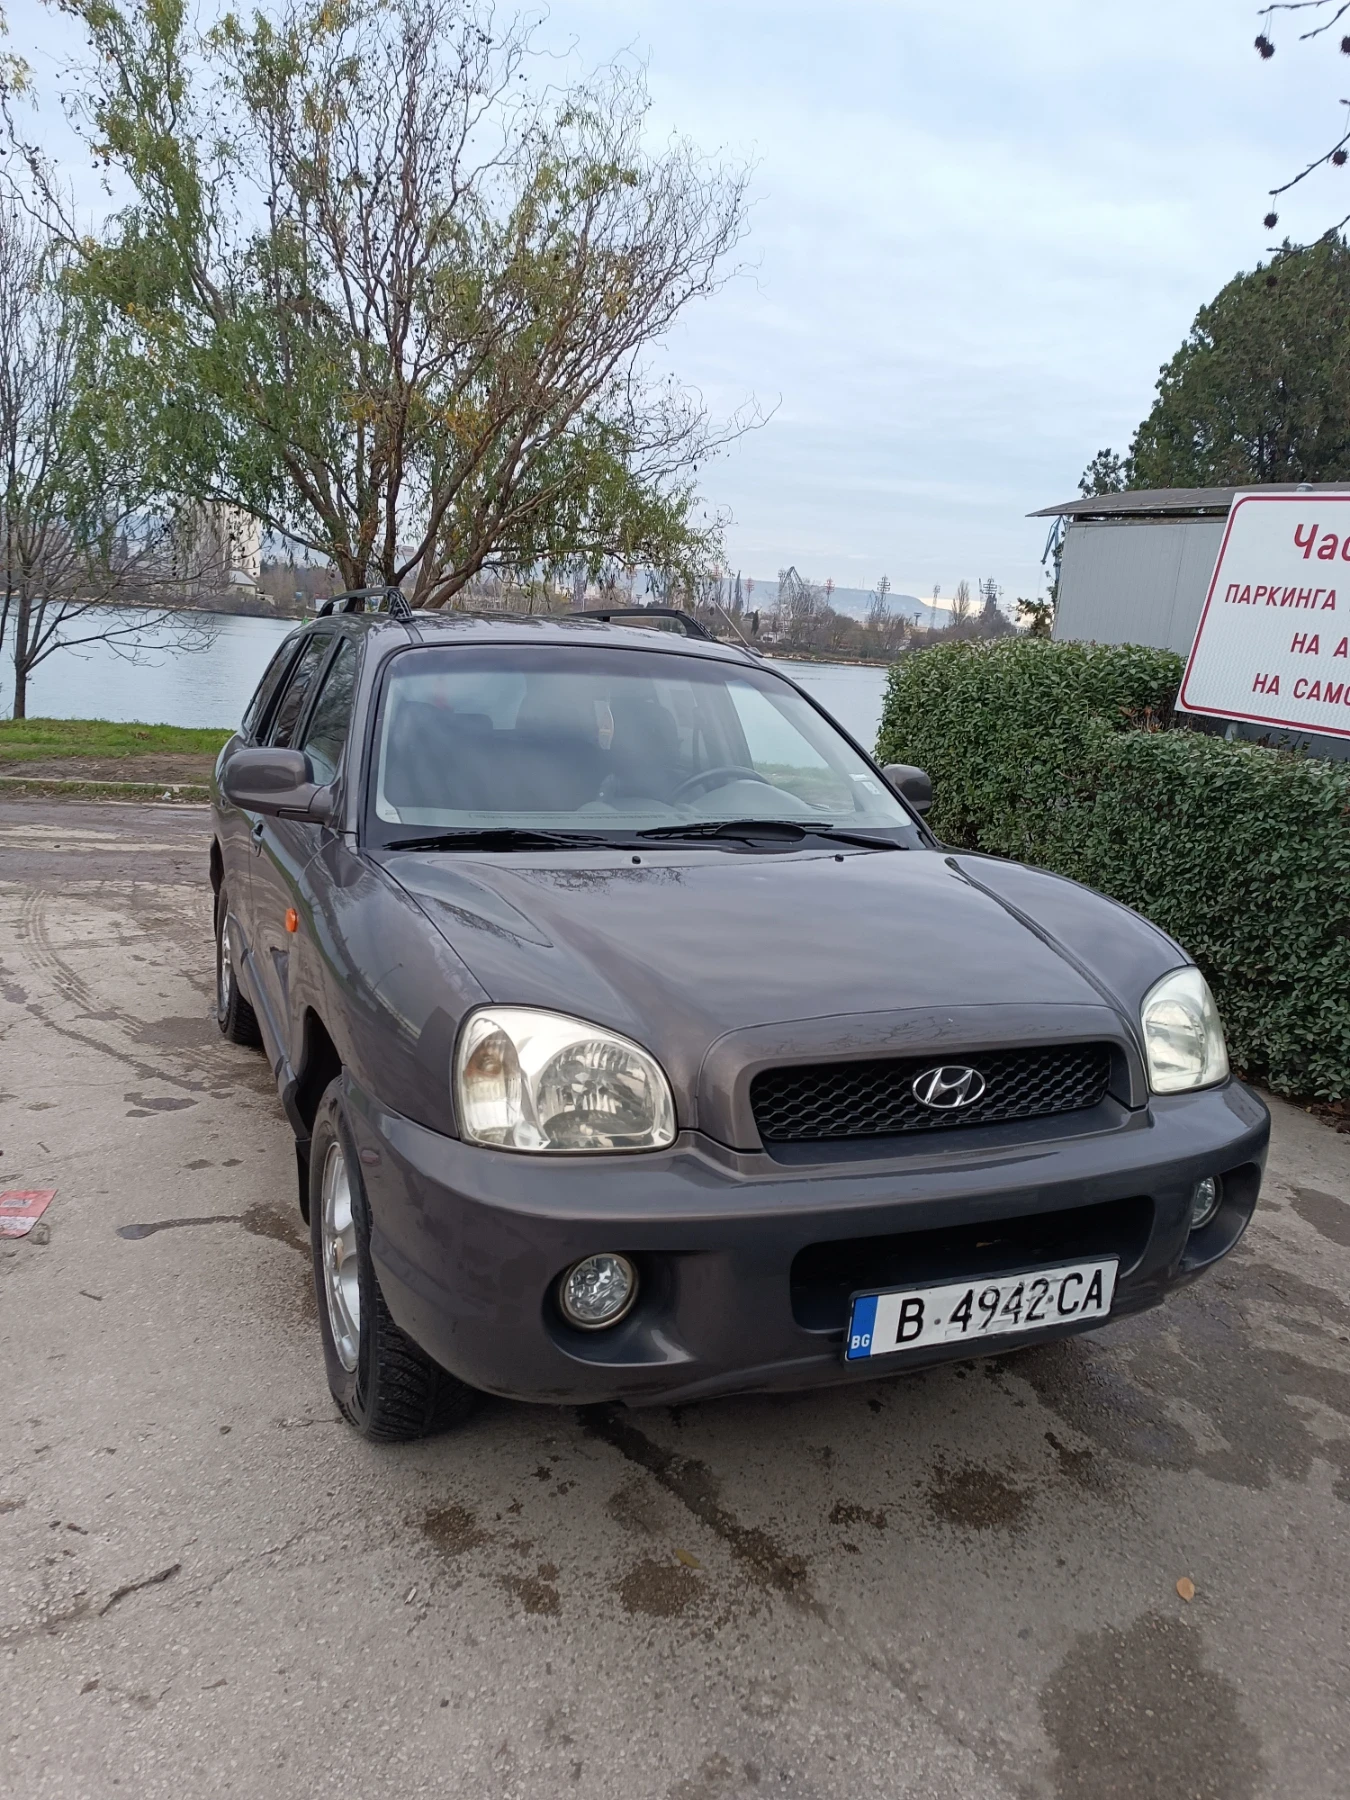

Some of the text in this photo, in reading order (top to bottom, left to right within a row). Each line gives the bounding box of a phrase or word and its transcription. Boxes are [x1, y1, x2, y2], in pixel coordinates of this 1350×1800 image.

[1225, 584, 1336, 611] ПАРКИНГА
[1290, 632, 1320, 655] НА
[1252, 673, 1280, 695] НА
[896, 1268, 1103, 1344] B 4942 CA
[851, 1334, 870, 1349] BG
